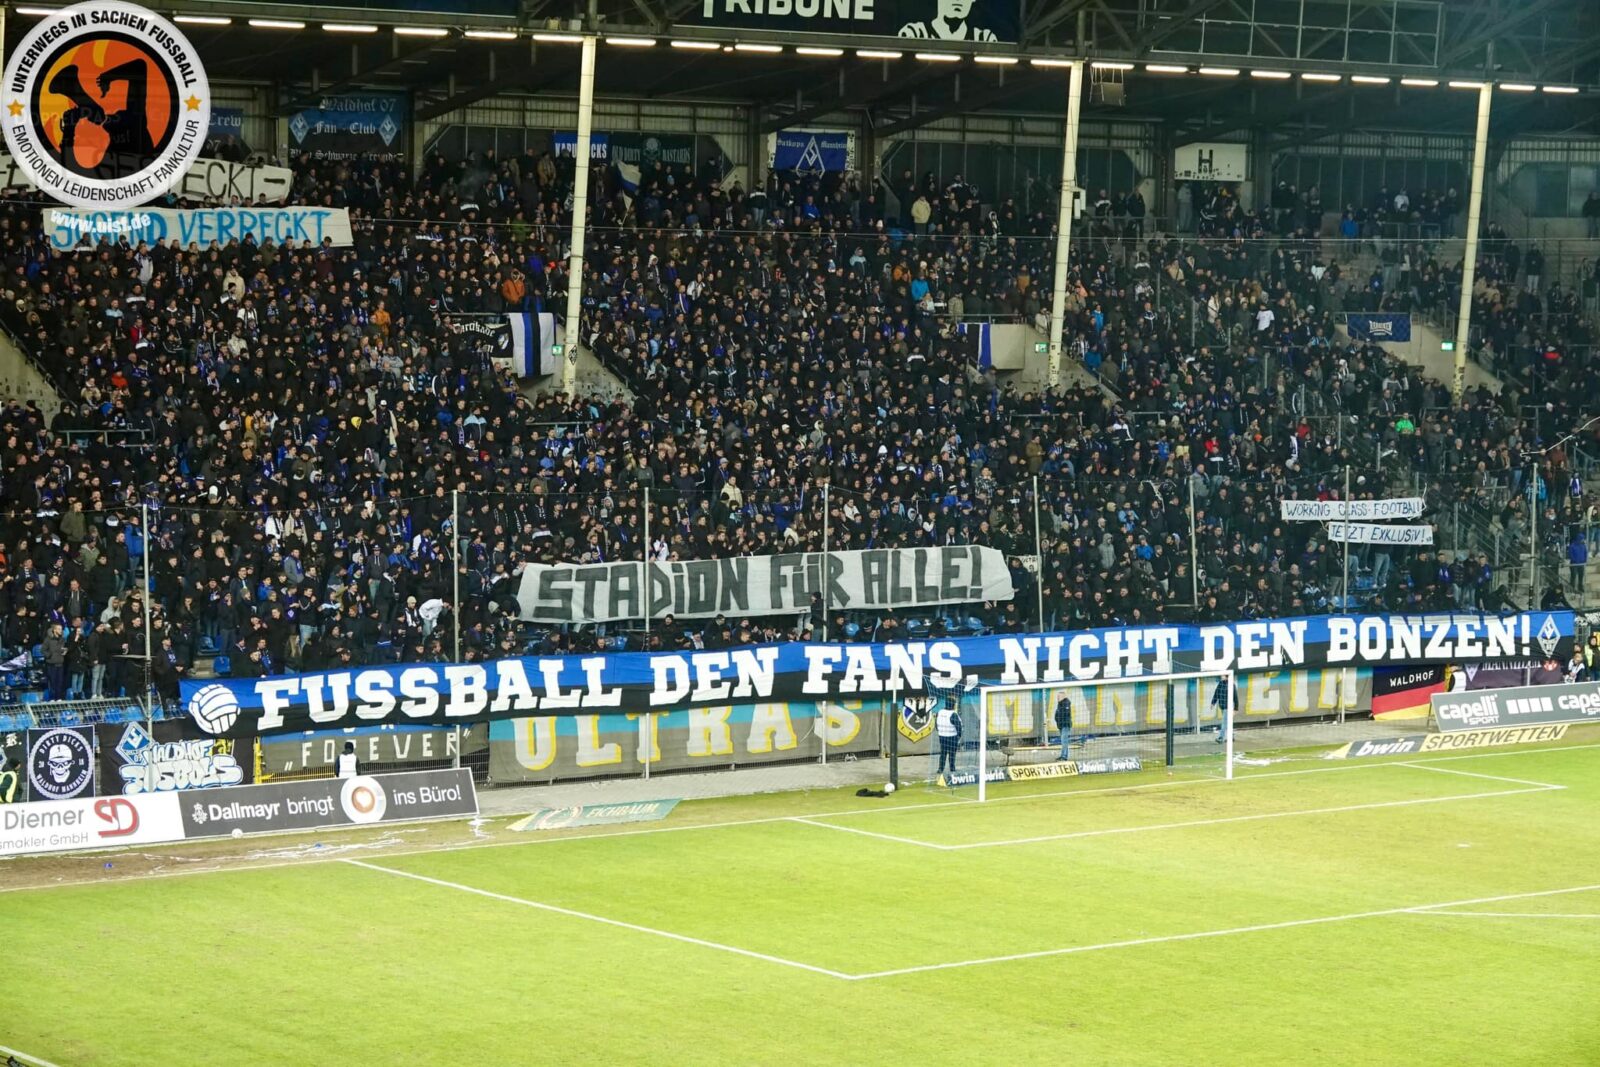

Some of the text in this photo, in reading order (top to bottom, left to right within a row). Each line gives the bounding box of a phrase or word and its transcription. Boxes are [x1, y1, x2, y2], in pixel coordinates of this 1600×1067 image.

[312, 120, 337, 135] Fan
[349, 120, 376, 135] Club
[178, 210, 331, 248] VERRECKT
[1338, 502, 1368, 517] CASS
[863, 546, 983, 607] ALLE!
[254, 655, 622, 732] FUSSBALL
[650, 647, 779, 707] DEN
[1000, 627, 1180, 685] NICHT
[1200, 619, 1308, 671] DEN
[1327, 613, 1531, 662] BONZEN!
[1390, 670, 1434, 688] WALDHOF
[1439, 693, 1500, 724] capelli
[1468, 715, 1500, 725] SPORT
[38, 734, 84, 755] DIRTY DICKS
[510, 700, 862, 771] ULTRAS
[1356, 724, 1568, 757] bwin SPORTWETTEN
[36, 769, 88, 793] WALDHOF MANNHEIM
[951, 772, 976, 785] bwin
[208, 784, 462, 822] Dallmayr bringt ins Büro!
[586, 802, 660, 818] EICHBAUM
[4, 808, 84, 831] Diemer
[50, 833, 89, 846] GmbH
